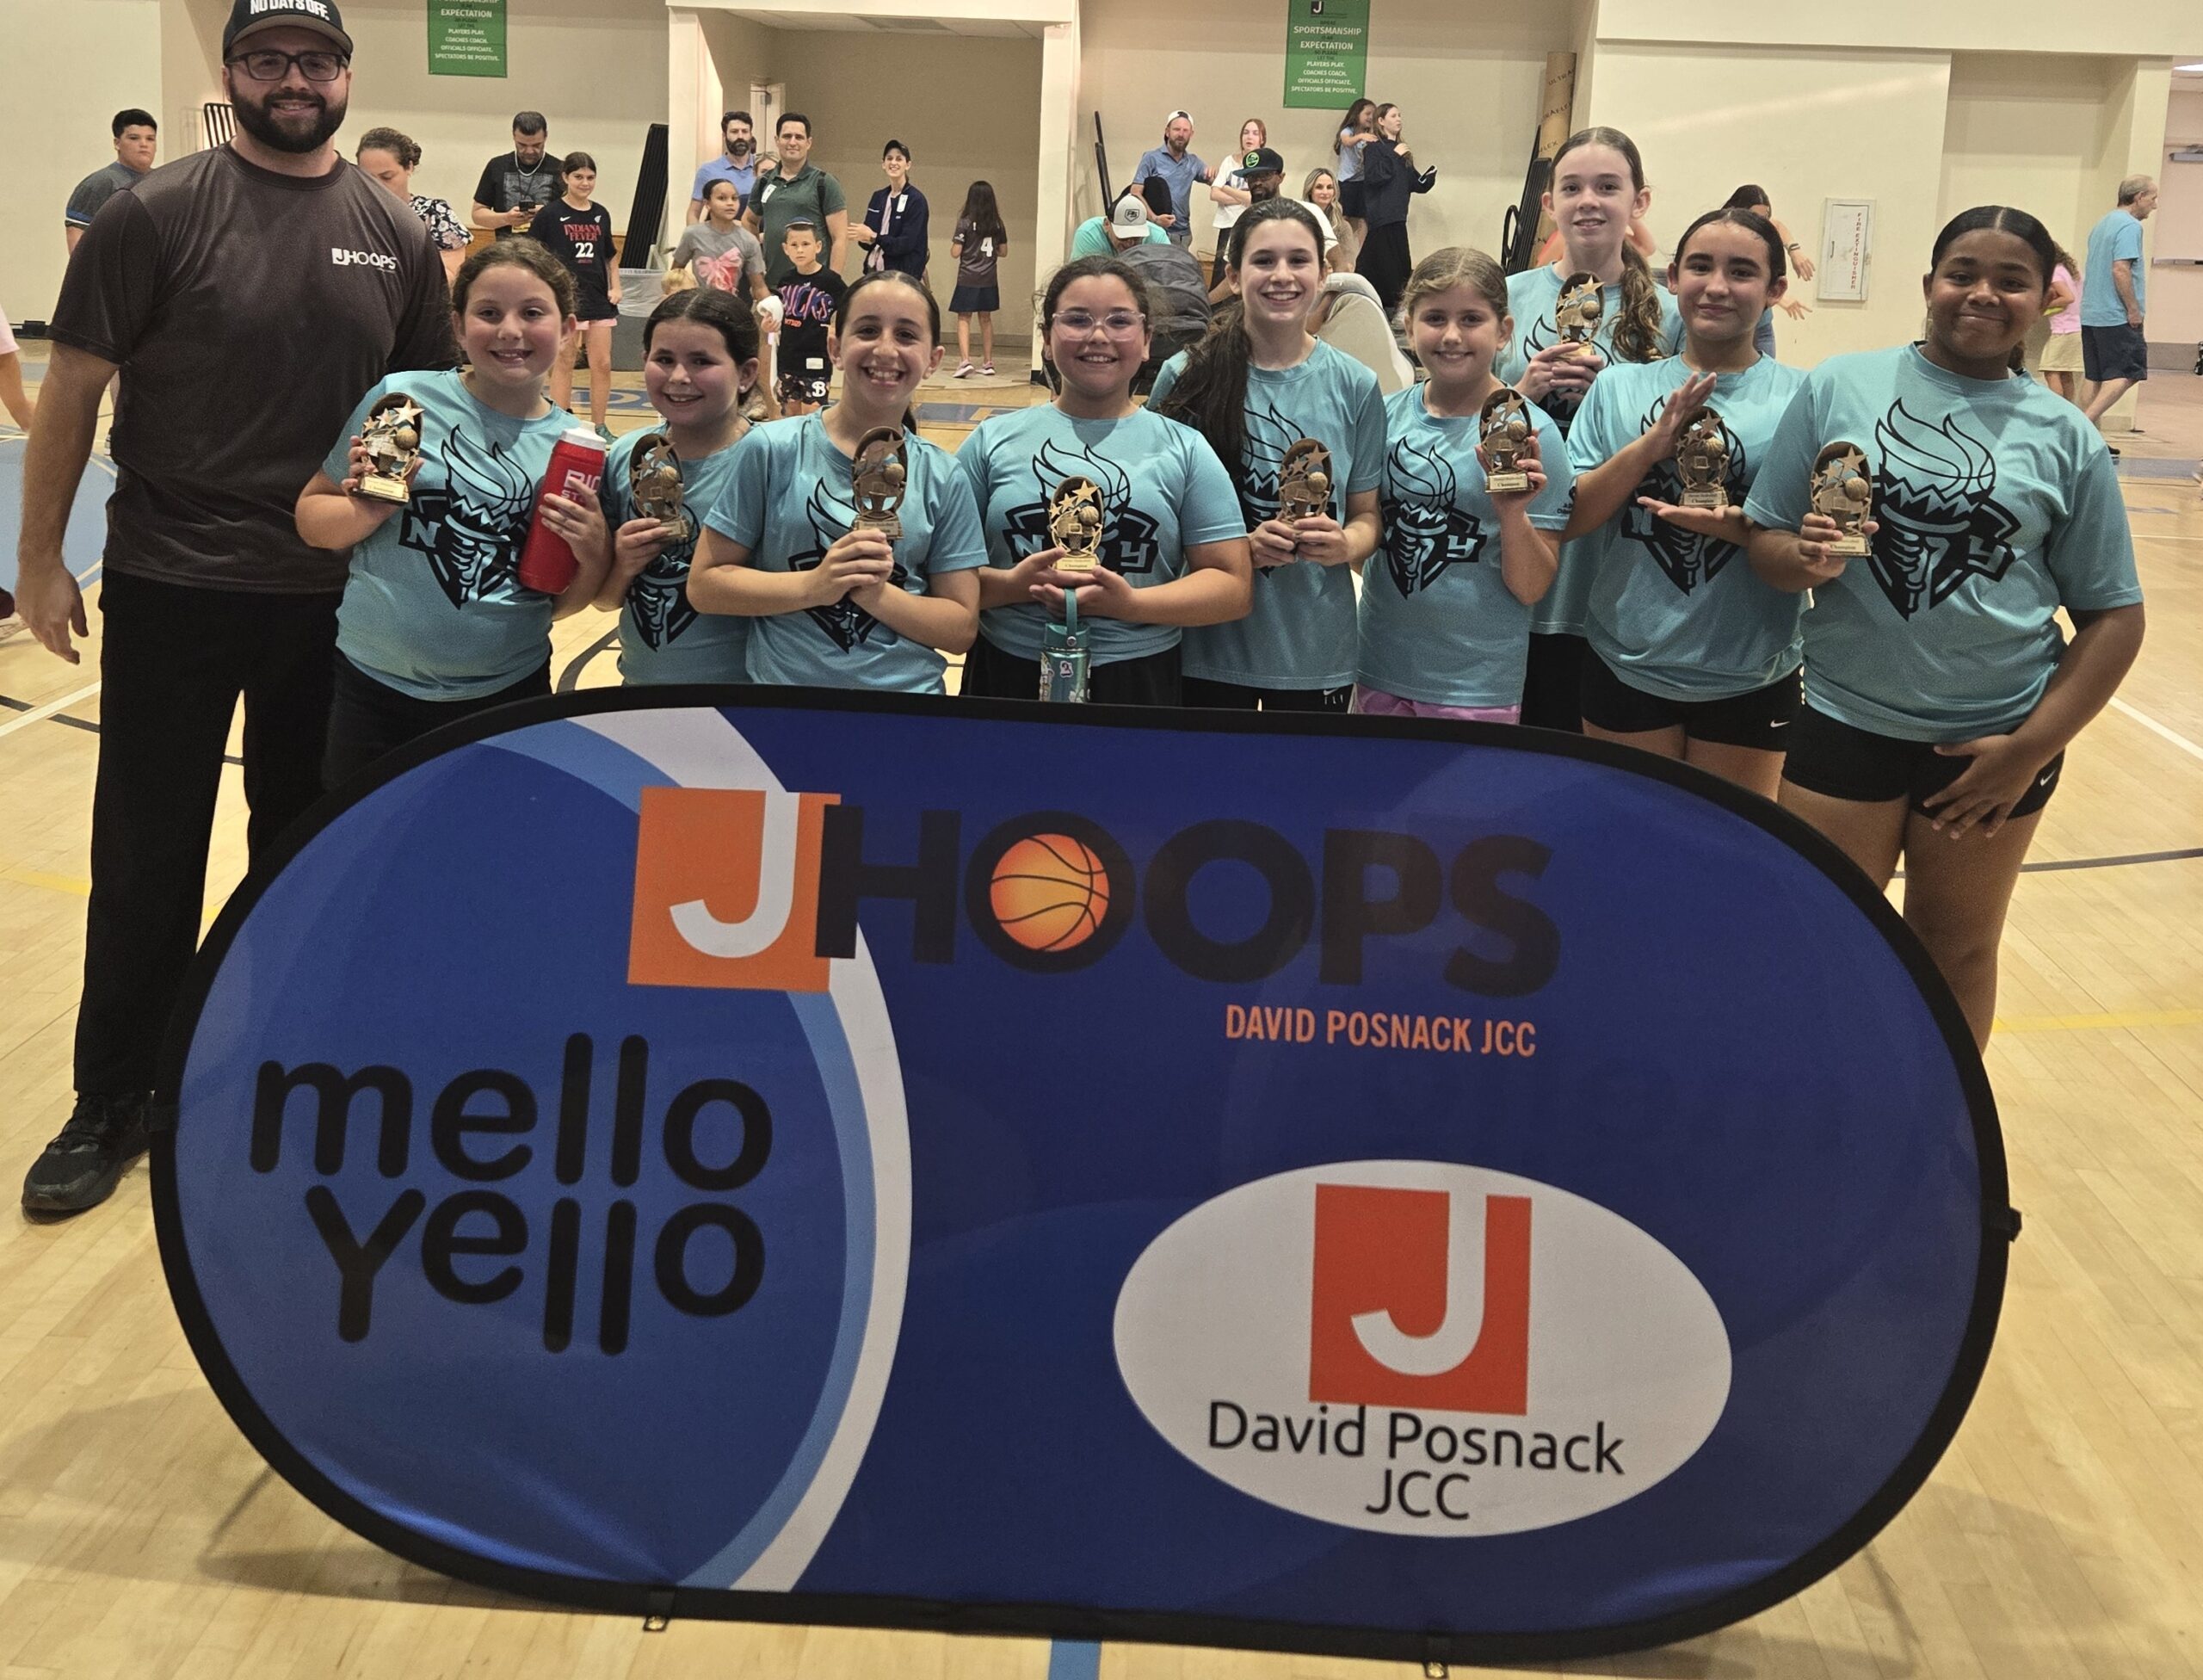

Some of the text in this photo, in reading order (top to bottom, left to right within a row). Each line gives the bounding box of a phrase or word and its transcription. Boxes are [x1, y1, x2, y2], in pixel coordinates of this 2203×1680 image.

[250, 0, 268, 15] NO
[269, 0, 305, 10] DAYS
[441, 9, 493, 18] EXPECTATION
[1312, 1, 1322, 14] J
[1293, 26, 1361, 35] SPORTSMANSHIP
[1300, 40, 1354, 50] EXPECTATION
[564, 224, 602, 236] INDIANA
[575, 242, 595, 258] 22
[980, 237, 994, 257] 4
[331, 248, 398, 269] JHOOPS
[1850, 232, 1861, 289] EXTINGUISHER
[406, 516, 441, 548] N
[1225, 1004, 1536, 1058] DAVID POSNACK JCC
[250, 1032, 774, 1192] mello
[304, 1185, 767, 1357] Yello
[1347, 1188, 1493, 1381] J
[1208, 1400, 1626, 1475] David Posnack
[1365, 1469, 1471, 1521] JCC
